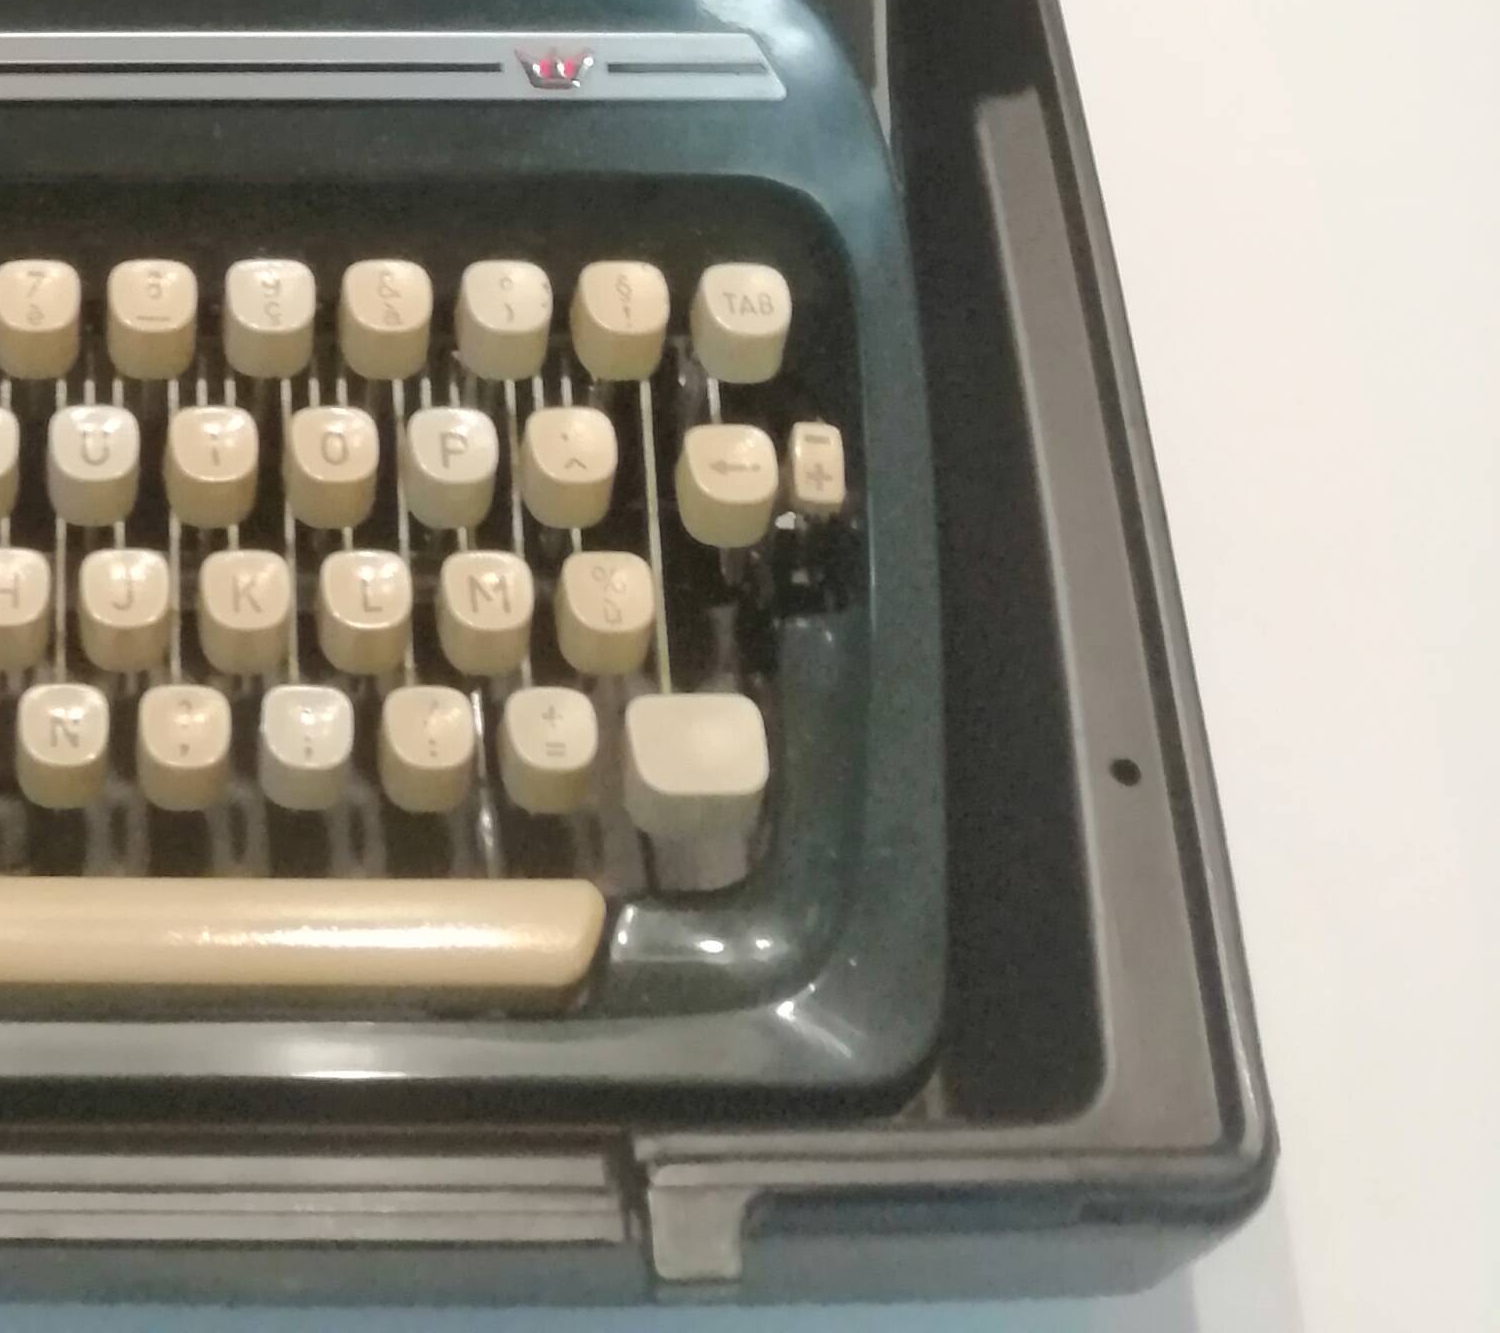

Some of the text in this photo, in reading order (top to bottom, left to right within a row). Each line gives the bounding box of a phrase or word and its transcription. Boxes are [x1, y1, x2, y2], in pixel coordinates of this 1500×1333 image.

[26, 270, 46, 299] 7
[722, 292, 775, 316] TAB
[81, 427, 111, 466] U
[320, 431, 350, 466] O
[440, 431, 469, 470] P
[111, 574, 134, 612] J
[230, 575, 263, 614] K
[359, 576, 383, 613] L
[467, 573, 512, 614] M
[49, 711, 82, 749] N
